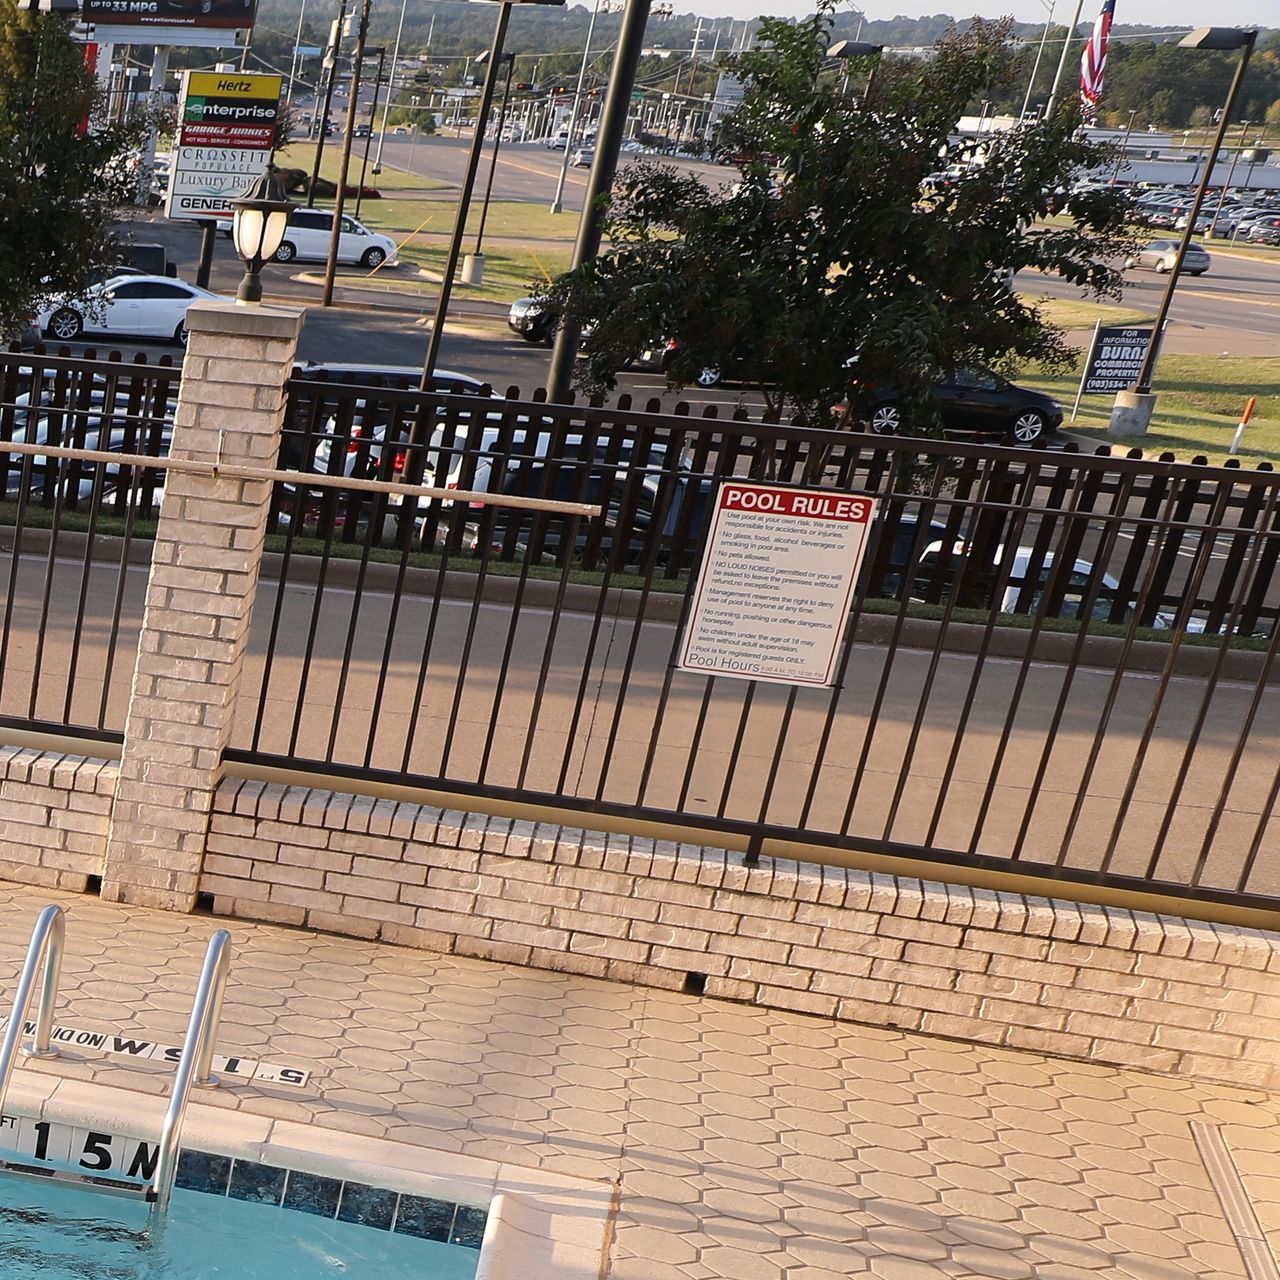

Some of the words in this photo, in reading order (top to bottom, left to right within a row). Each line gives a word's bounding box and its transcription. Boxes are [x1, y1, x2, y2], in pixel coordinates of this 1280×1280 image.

[112, 2, 127, 11] 33
[130, 2, 158, 12] MPG
[217, 80, 252, 92] Hertz
[186, 103, 276, 119] enterprise
[185, 125, 228, 134] GARAGE
[228, 127, 272, 136] JUNKIES
[195, 162, 251, 171] POPULACE
[180, 173, 227, 190] Luxury
[1096, 369, 1140, 377] PROPERTIE
[725, 489, 788, 511] POOL
[791, 495, 866, 518] RULES
[740, 513, 756, 522] pool
[764, 517, 779, 525] your
[724, 520, 764, 532] responsible
[774, 525, 808, 534] accidents
[719, 540, 749, 549] smoking
[757, 543, 772, 552] pool
[773, 536, 799, 544] alcohol
[800, 539, 836, 549] beverages
[728, 551, 743, 559] pets
[727, 562, 747, 570] LOUD
[748, 564, 775, 573] NOISES
[774, 567, 807, 578] permitted
[816, 573, 829, 581] you
[722, 570, 742, 578] asked
[781, 577, 812, 587] premises
[813, 580, 838, 588] without
[708, 588, 750, 600] Management
[792, 597, 809, 606] right
[816, 600, 834, 609] deny
[727, 599, 743, 607] pool
[751, 603, 776, 611] anyone
[742, 613, 769, 623] pushing
[796, 619, 832, 631] dangerous
[697, 634, 715, 642] swim
[716, 637, 740, 645] without
[710, 628, 737, 636] children
[737, 631, 757, 639] under
[768, 636, 781, 644] age
[799, 640, 814, 648] may
[688, 653, 718, 667] Pool
[720, 657, 761, 673] Hours
[727, 649, 761, 660] registered
[761, 653, 784, 663] guests
[76, 1032, 104, 1050] NO
